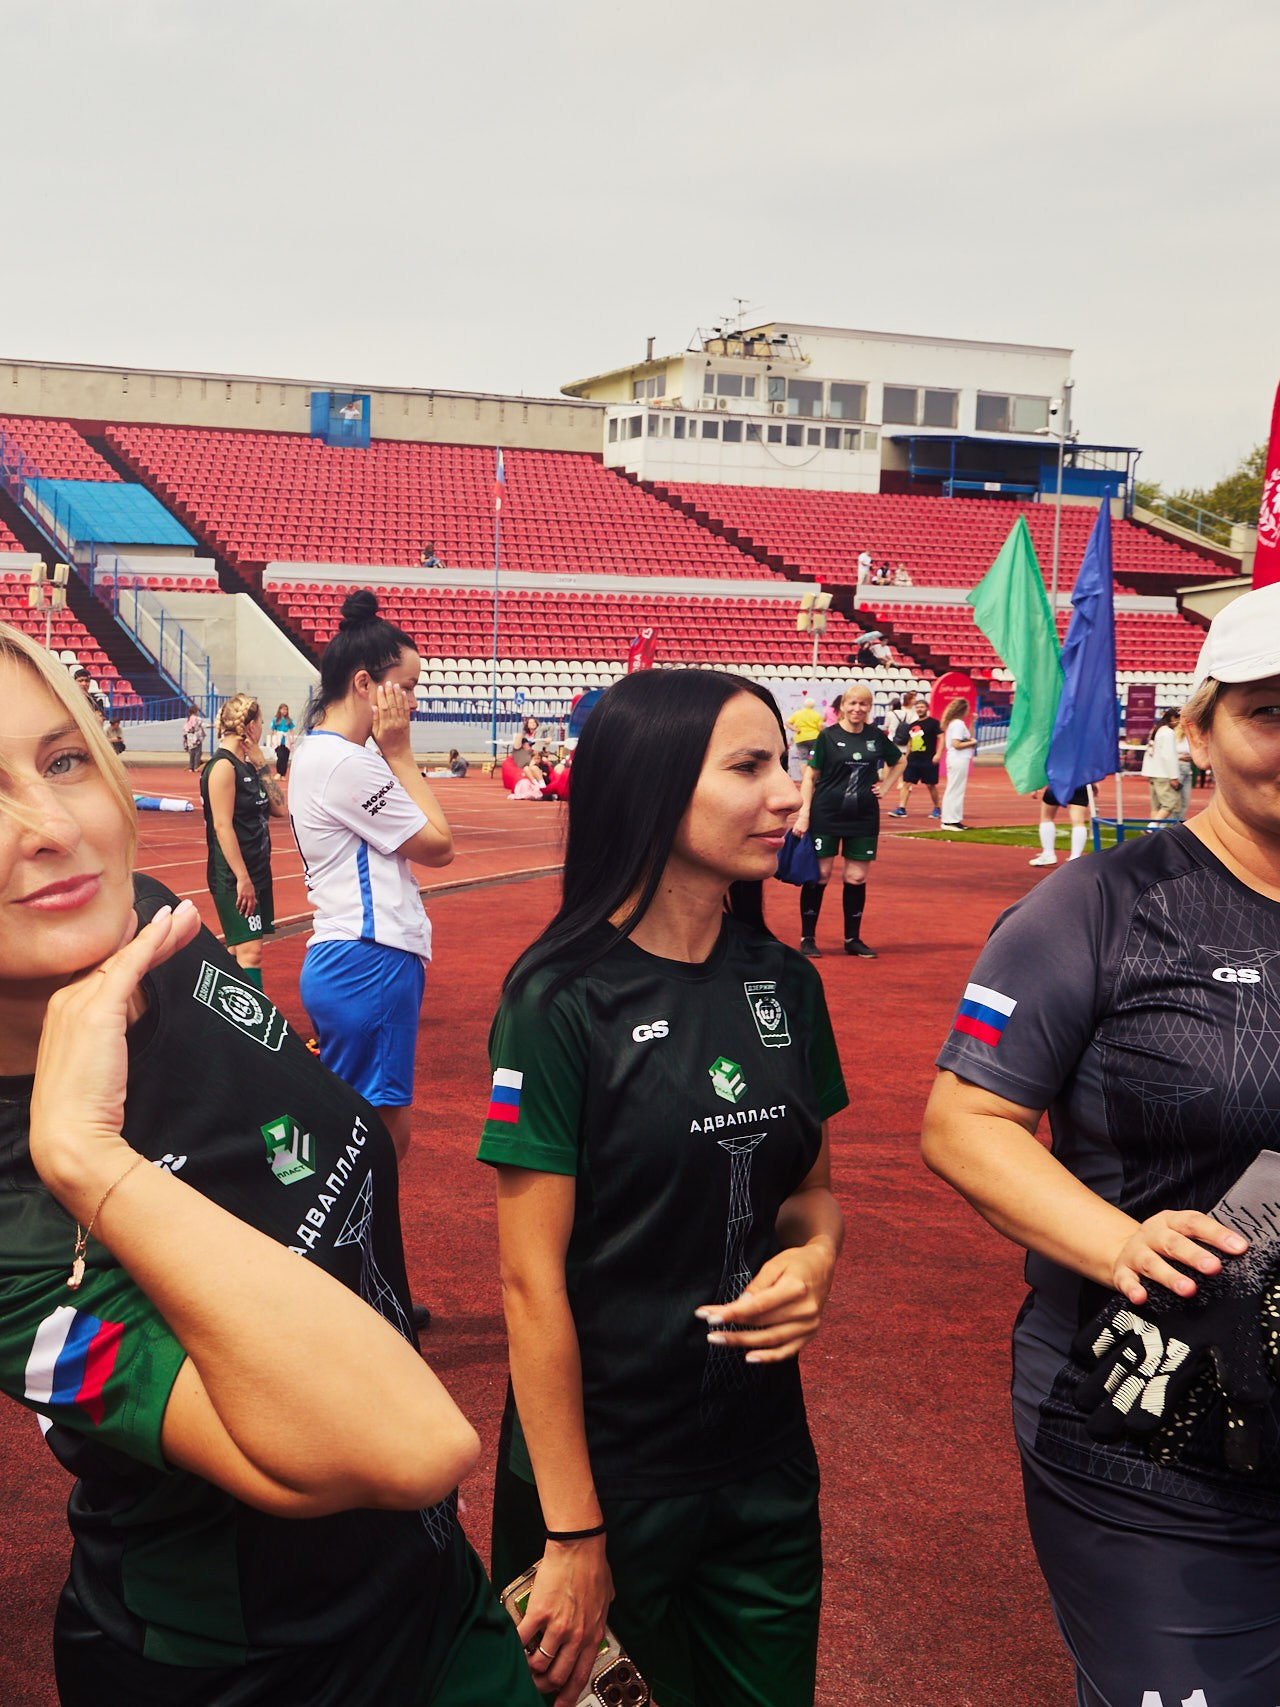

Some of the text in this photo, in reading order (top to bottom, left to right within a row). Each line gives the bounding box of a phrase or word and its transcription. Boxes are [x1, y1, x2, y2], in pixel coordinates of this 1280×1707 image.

[815, 838, 822, 850] 3
[248, 914, 262, 932] 88
[1212, 967, 1261, 984] GS
[632, 1020, 669, 1042] GS
[690, 1105, 786, 1133] АДВАПЛАСТ
[276, 1164, 306, 1179] ПЛАСТ
